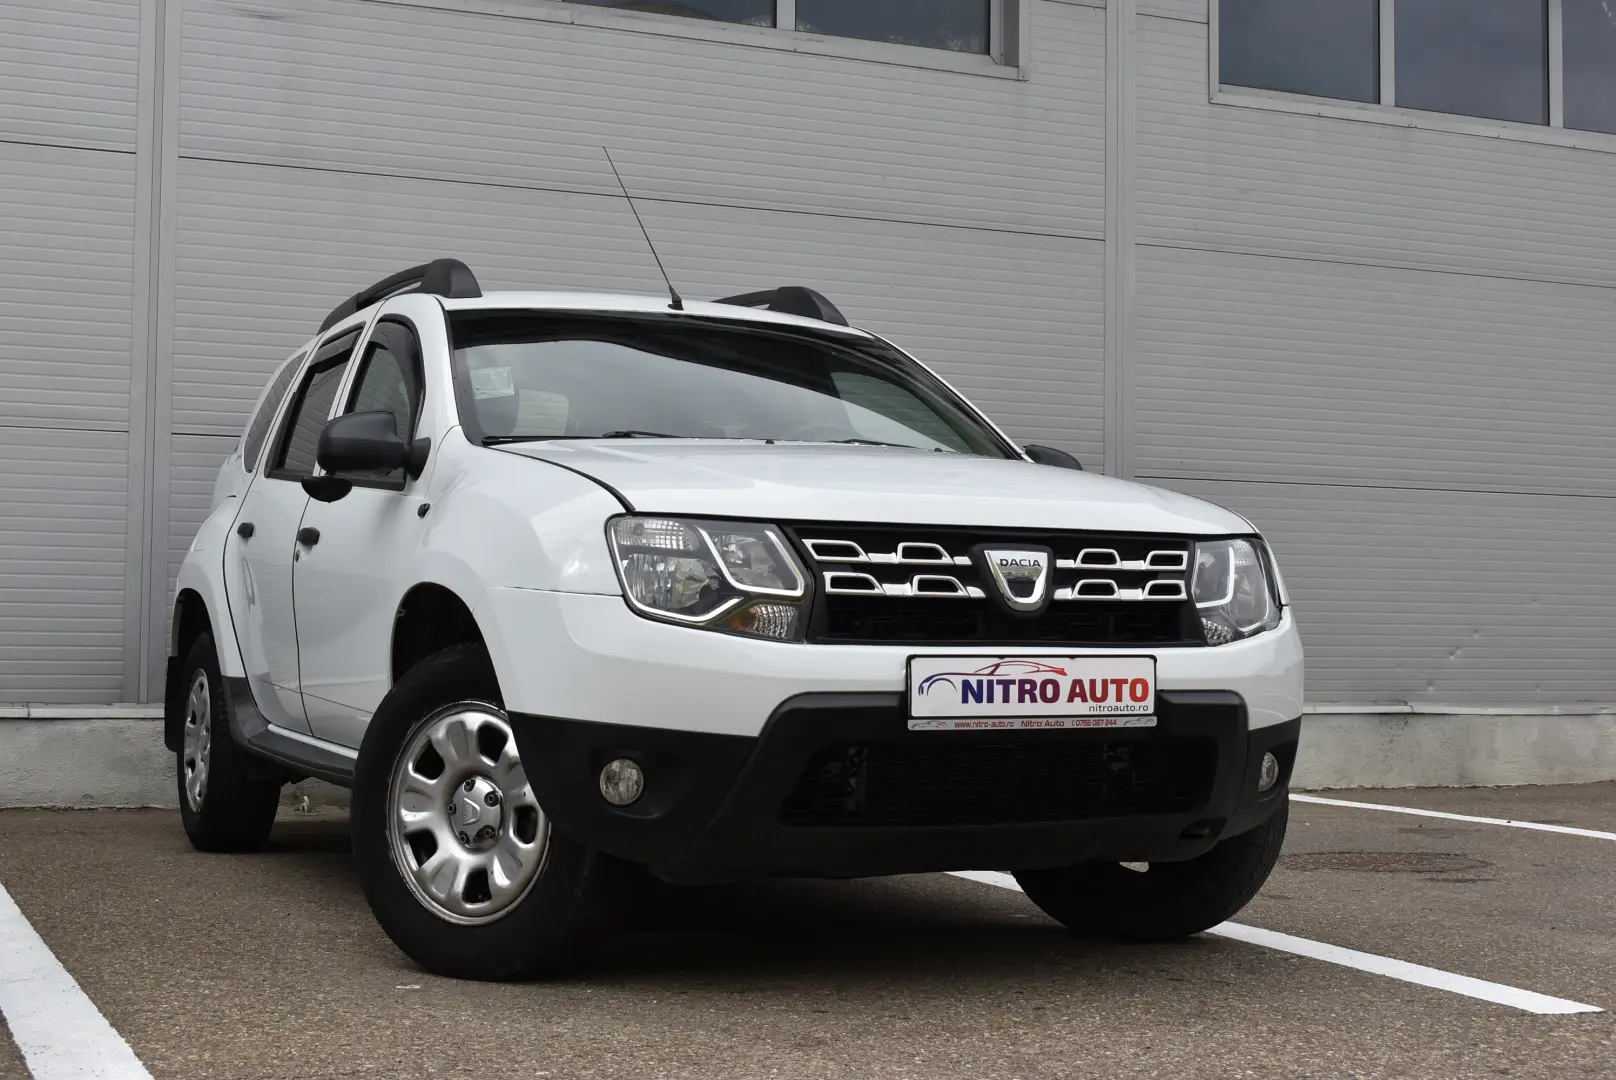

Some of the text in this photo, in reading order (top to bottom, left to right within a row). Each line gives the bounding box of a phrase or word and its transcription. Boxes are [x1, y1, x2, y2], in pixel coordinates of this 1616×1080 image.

[999, 558, 1041, 567] DACIA
[961, 678, 1149, 704] NITRO AUTO
[1089, 704, 1149, 712] nitroauto.ro
[954, 720, 1014, 728] www.nitro-auto.ro
[1021, 719, 1042, 728] Nitro
[1044, 719, 1065, 727] Auto
